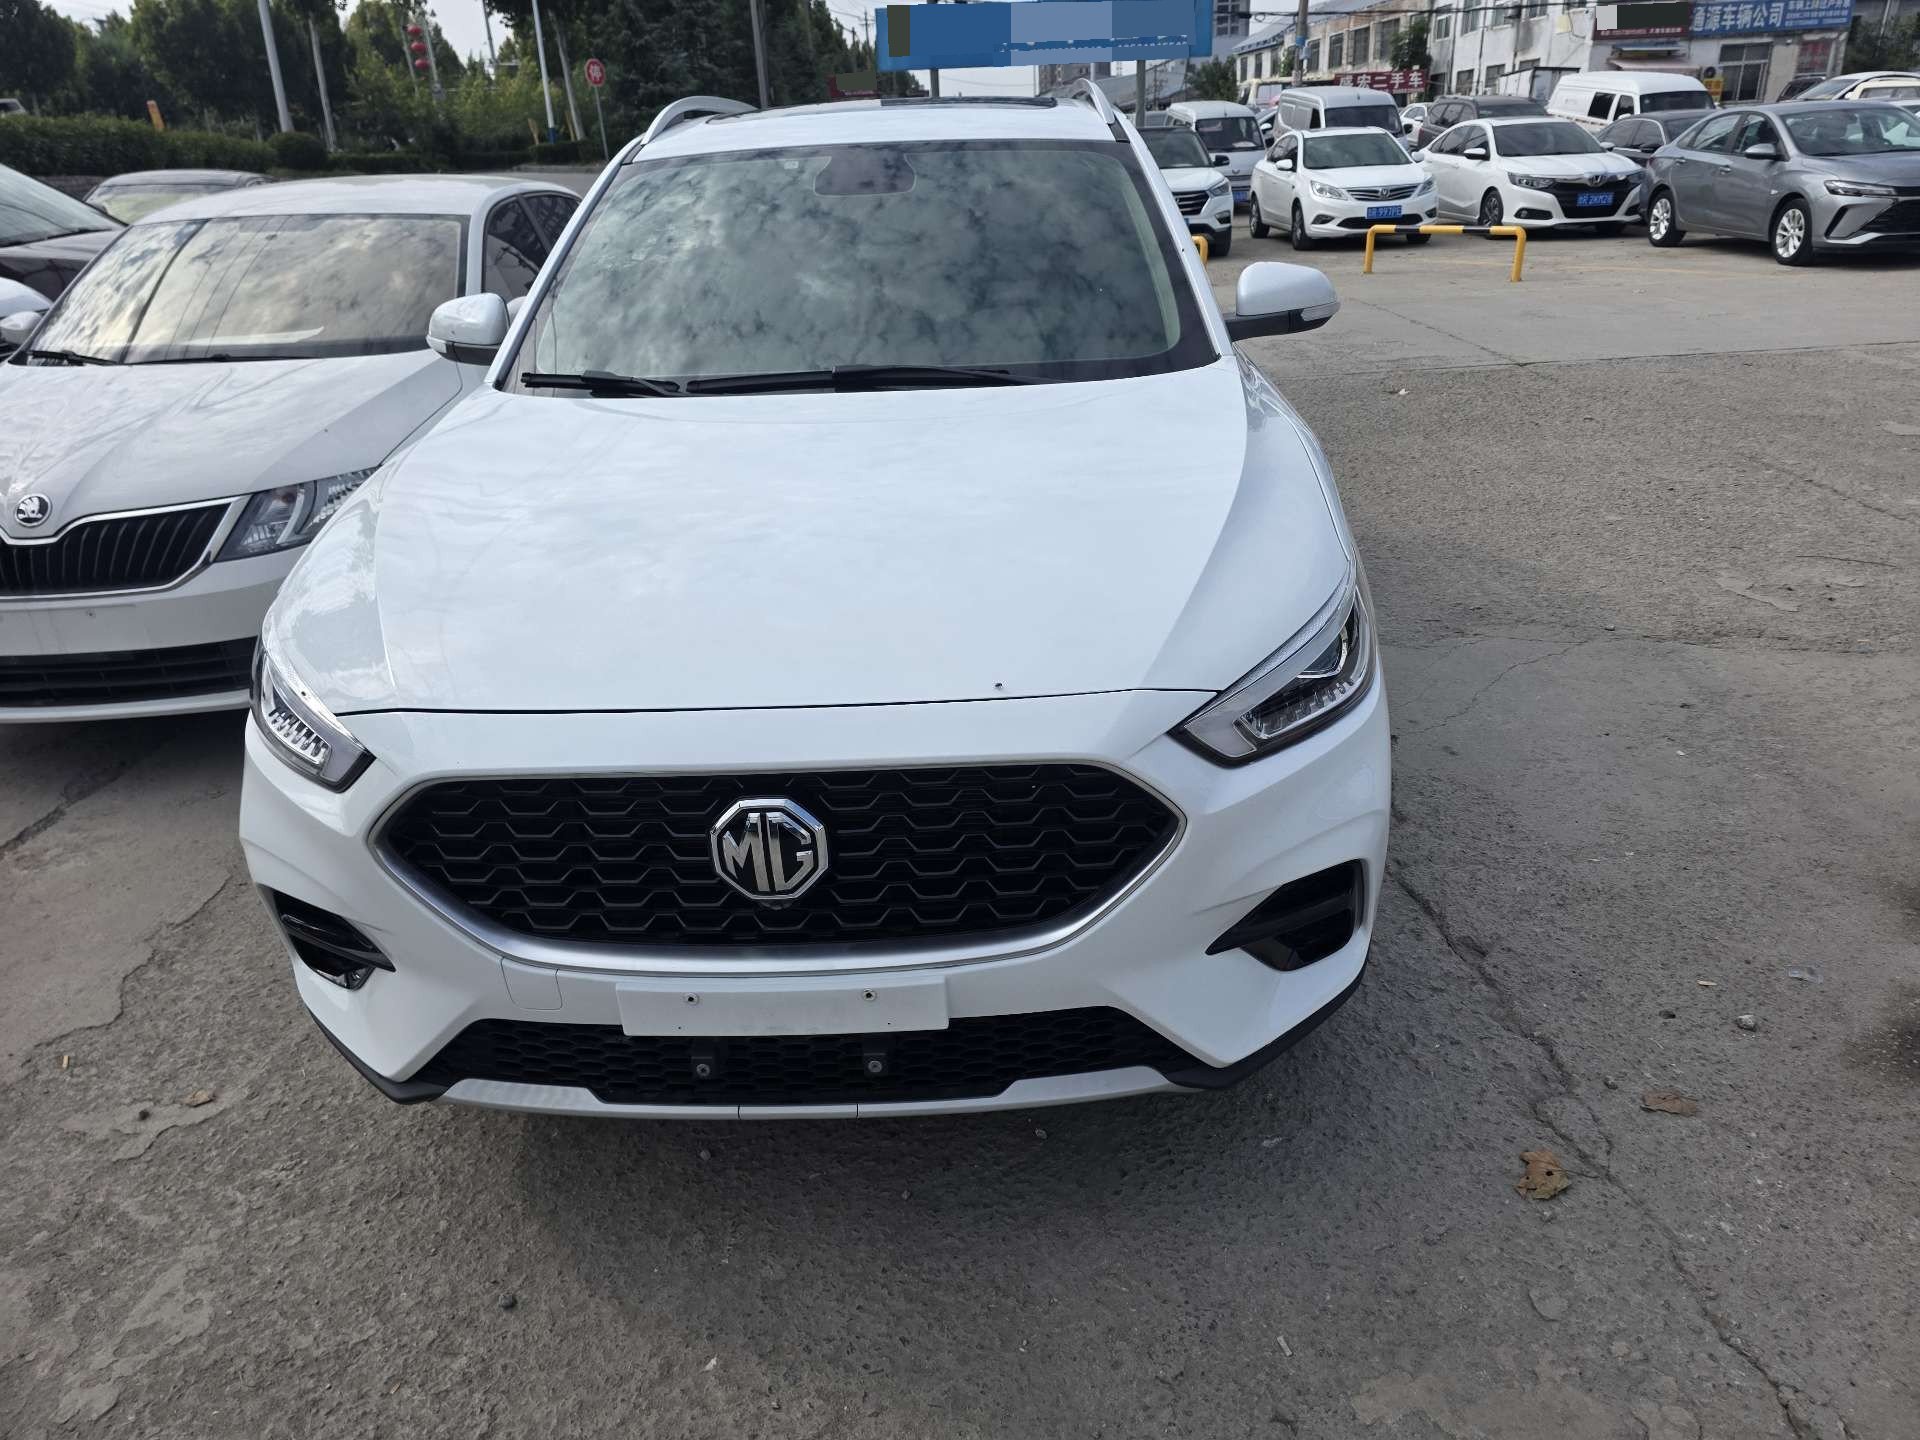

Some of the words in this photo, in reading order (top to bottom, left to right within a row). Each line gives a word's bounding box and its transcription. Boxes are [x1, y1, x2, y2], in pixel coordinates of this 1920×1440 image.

[1689, 3, 1784, 31] 通源车辆公司
[721, 811, 815, 892] MG
